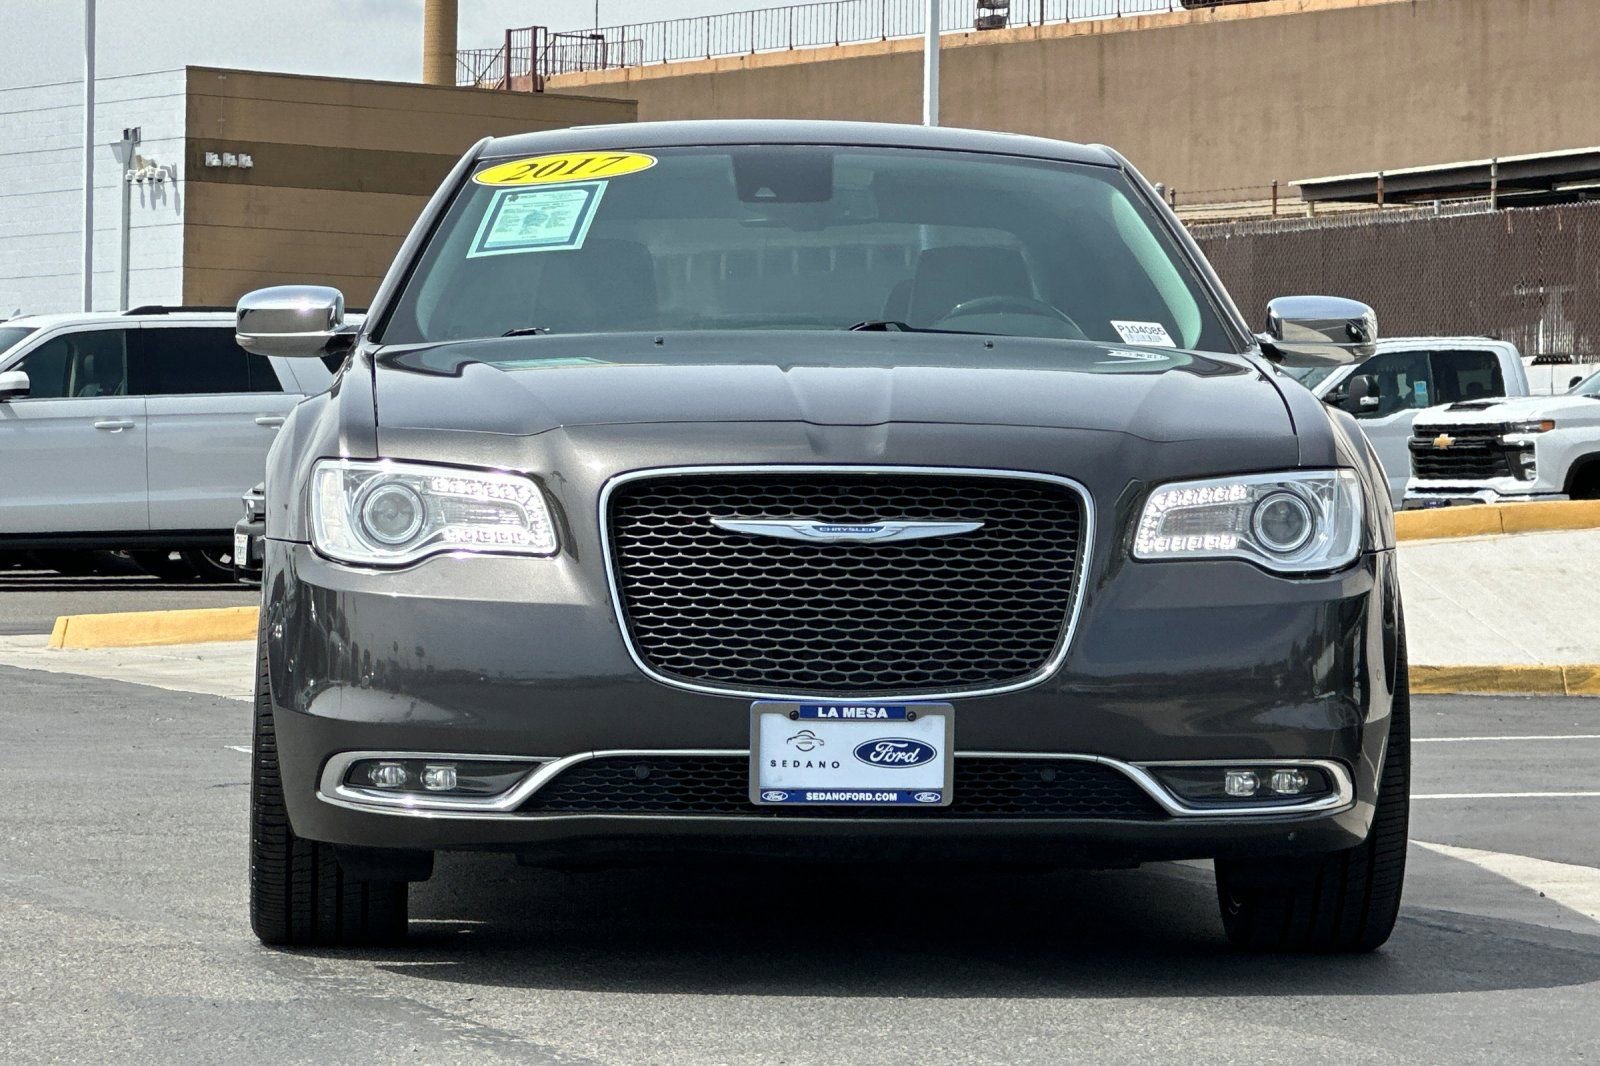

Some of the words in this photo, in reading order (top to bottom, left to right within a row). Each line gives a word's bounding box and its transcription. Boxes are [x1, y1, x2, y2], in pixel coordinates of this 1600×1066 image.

[500, 155, 631, 182] 2017
[1117, 324, 1166, 336] P104085
[817, 707, 838, 719] LA
[842, 707, 888, 719] MESA
[870, 741, 920, 763] Ford
[770, 759, 841, 769] SEDANO
[805, 792, 897, 802] SEDANOFORD.COM
